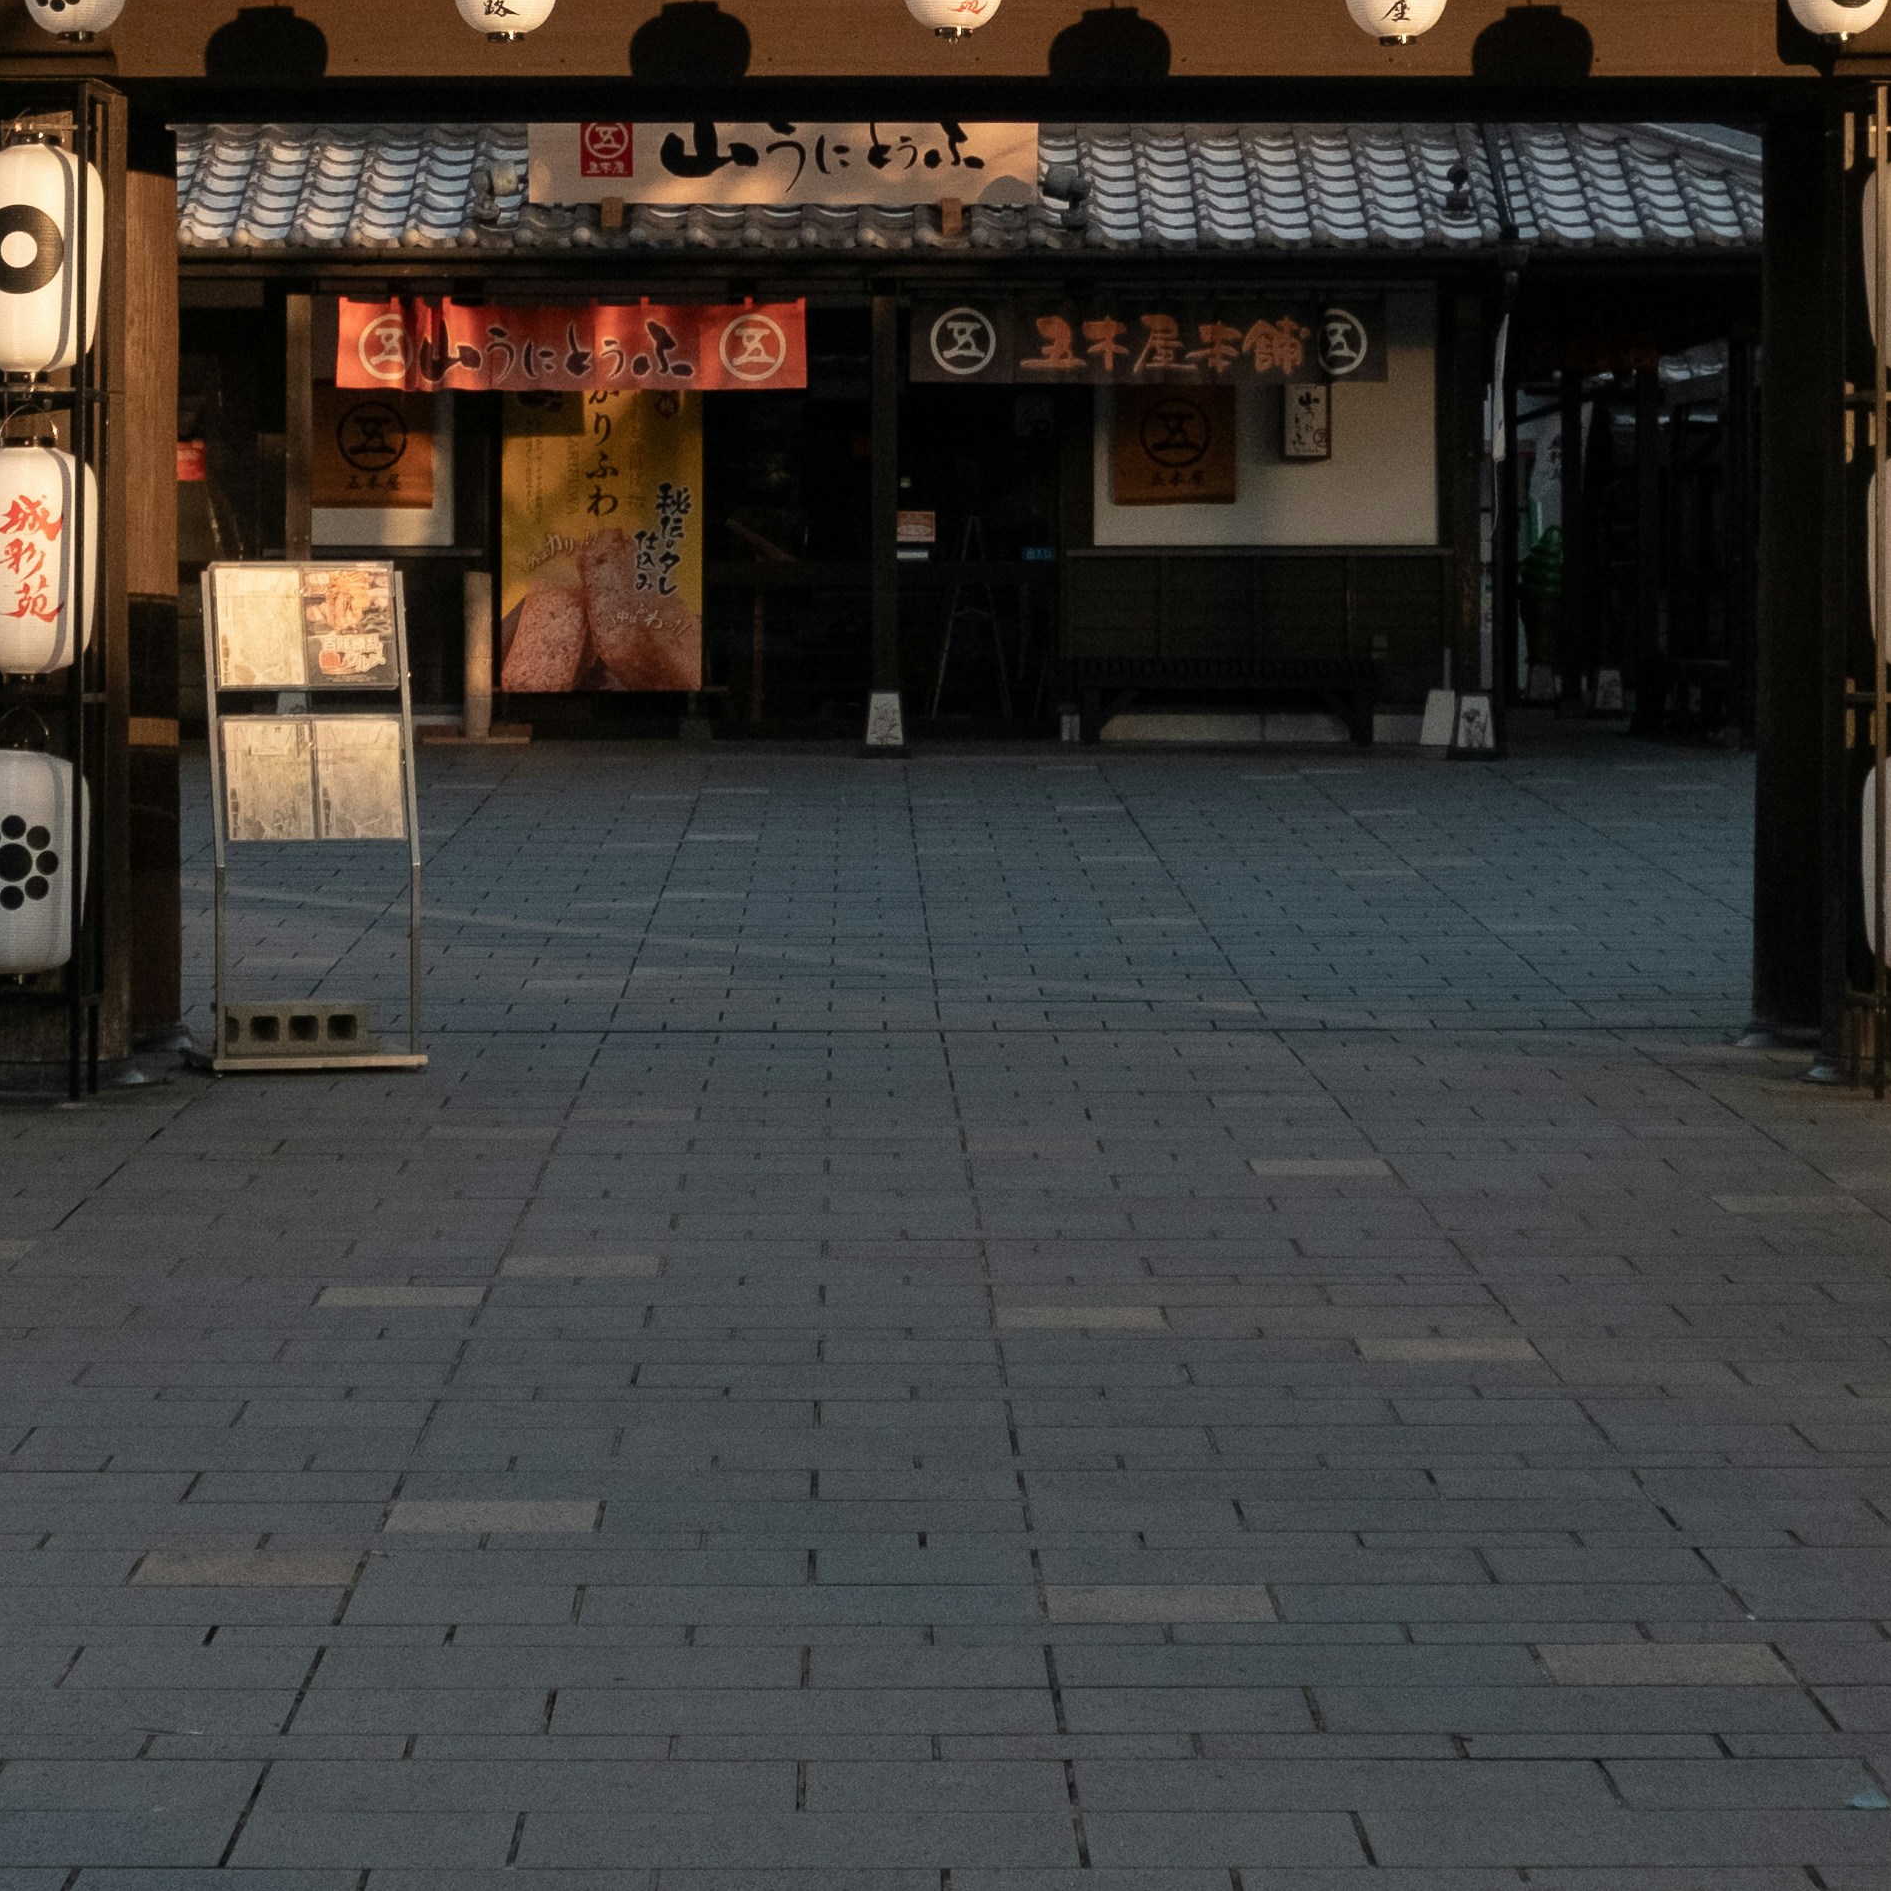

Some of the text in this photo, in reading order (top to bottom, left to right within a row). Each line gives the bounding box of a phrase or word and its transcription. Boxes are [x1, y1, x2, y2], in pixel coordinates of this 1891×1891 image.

[419, 320, 694, 383] 山うにとうふ
[1020, 313, 1310, 376] 五木屋本舗
[633, 529, 659, 592] 仕込み
